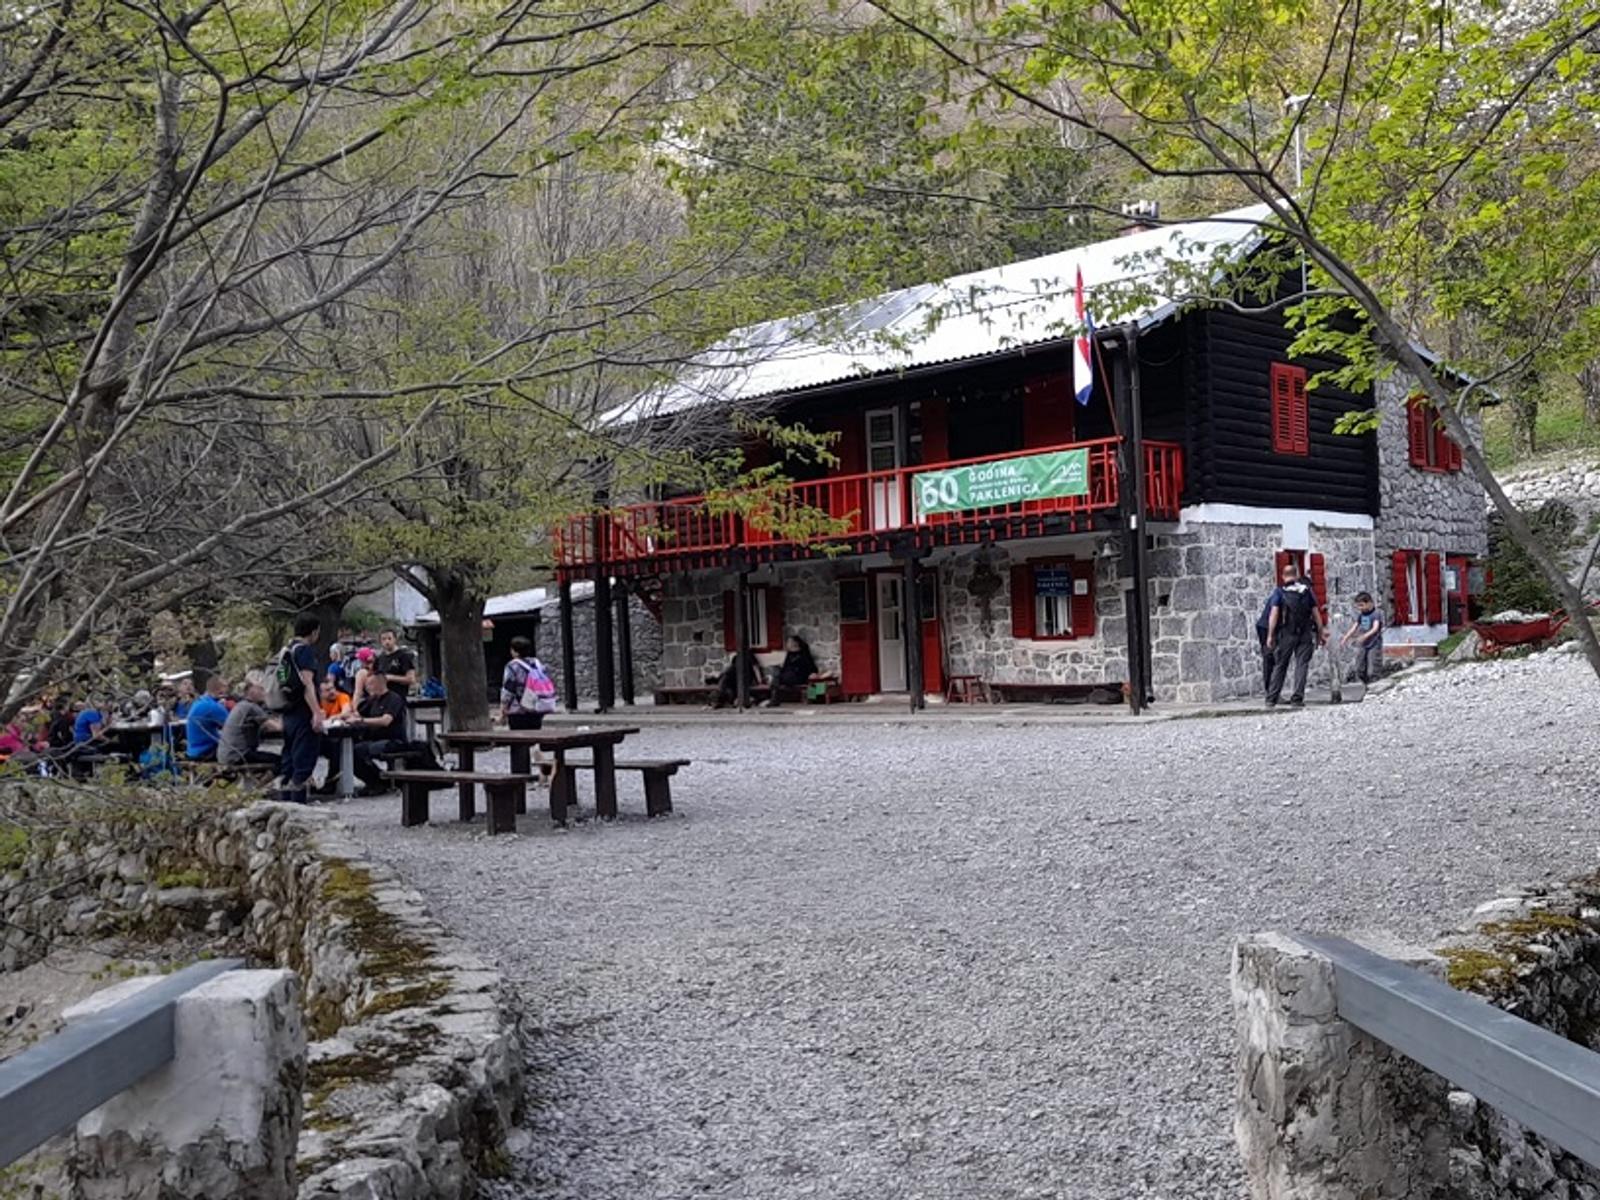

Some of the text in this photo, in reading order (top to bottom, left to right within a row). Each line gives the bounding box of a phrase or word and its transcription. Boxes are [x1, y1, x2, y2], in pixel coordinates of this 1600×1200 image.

[968, 466, 1016, 483] GODINA
[922, 475, 959, 508] 60
[969, 483, 1041, 503] PAKLENICA
